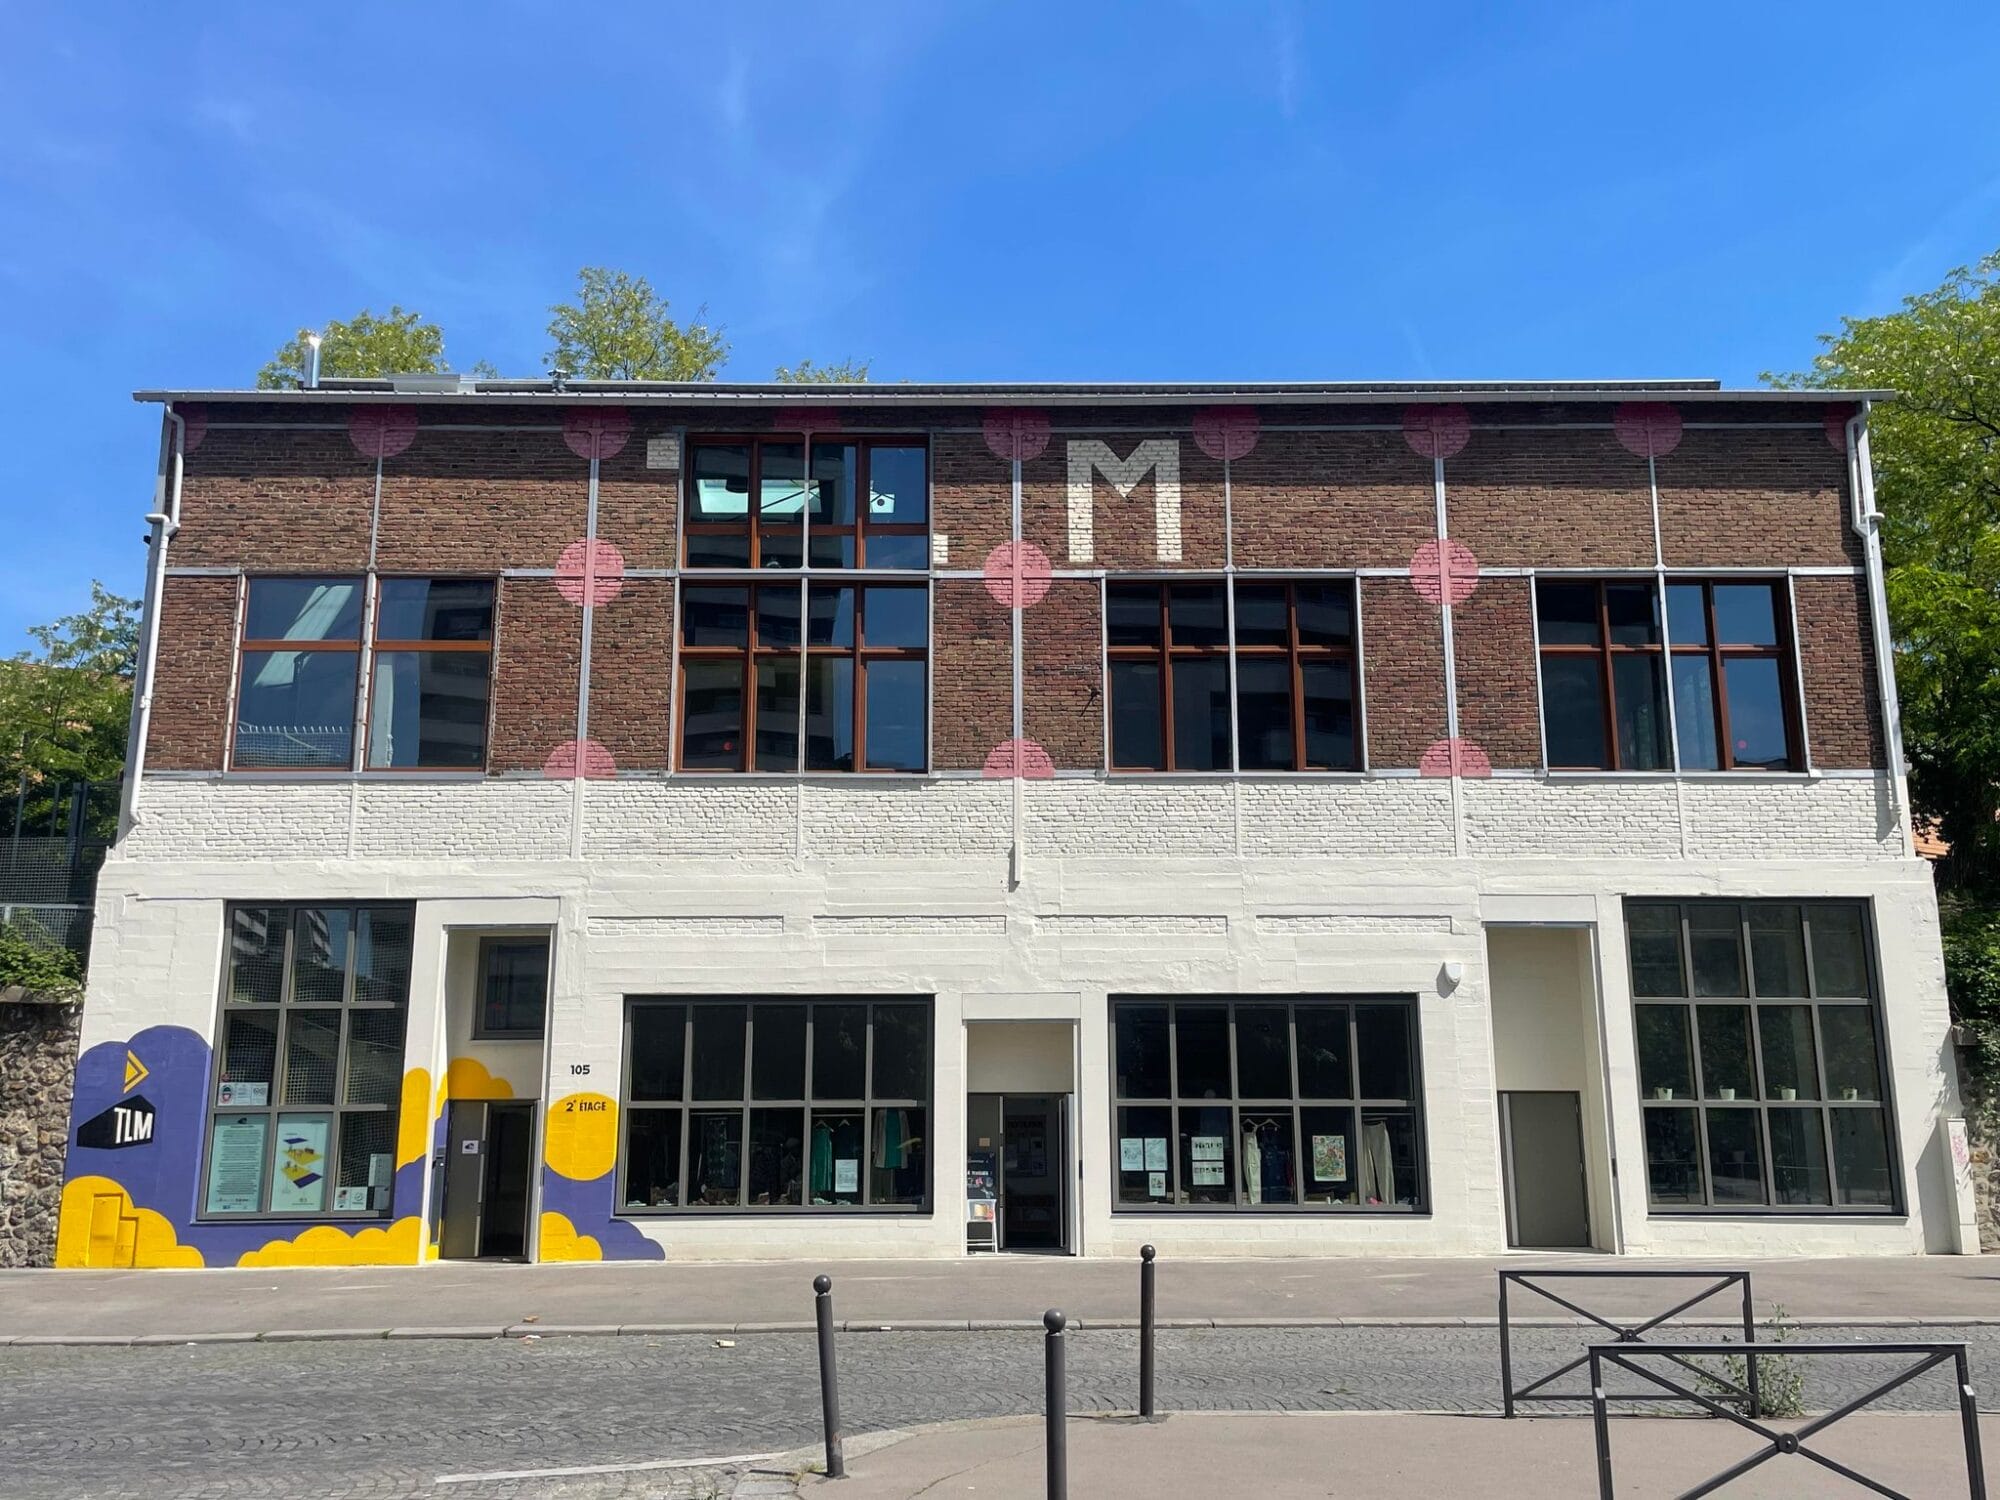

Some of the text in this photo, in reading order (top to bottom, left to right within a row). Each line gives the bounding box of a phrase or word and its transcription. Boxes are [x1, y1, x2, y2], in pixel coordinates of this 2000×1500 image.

[1066, 439, 1182, 562] M
[570, 1065, 590, 1075] 105
[579, 1099, 606, 1112] ÉTAGE
[113, 1106, 154, 1145] TLM
